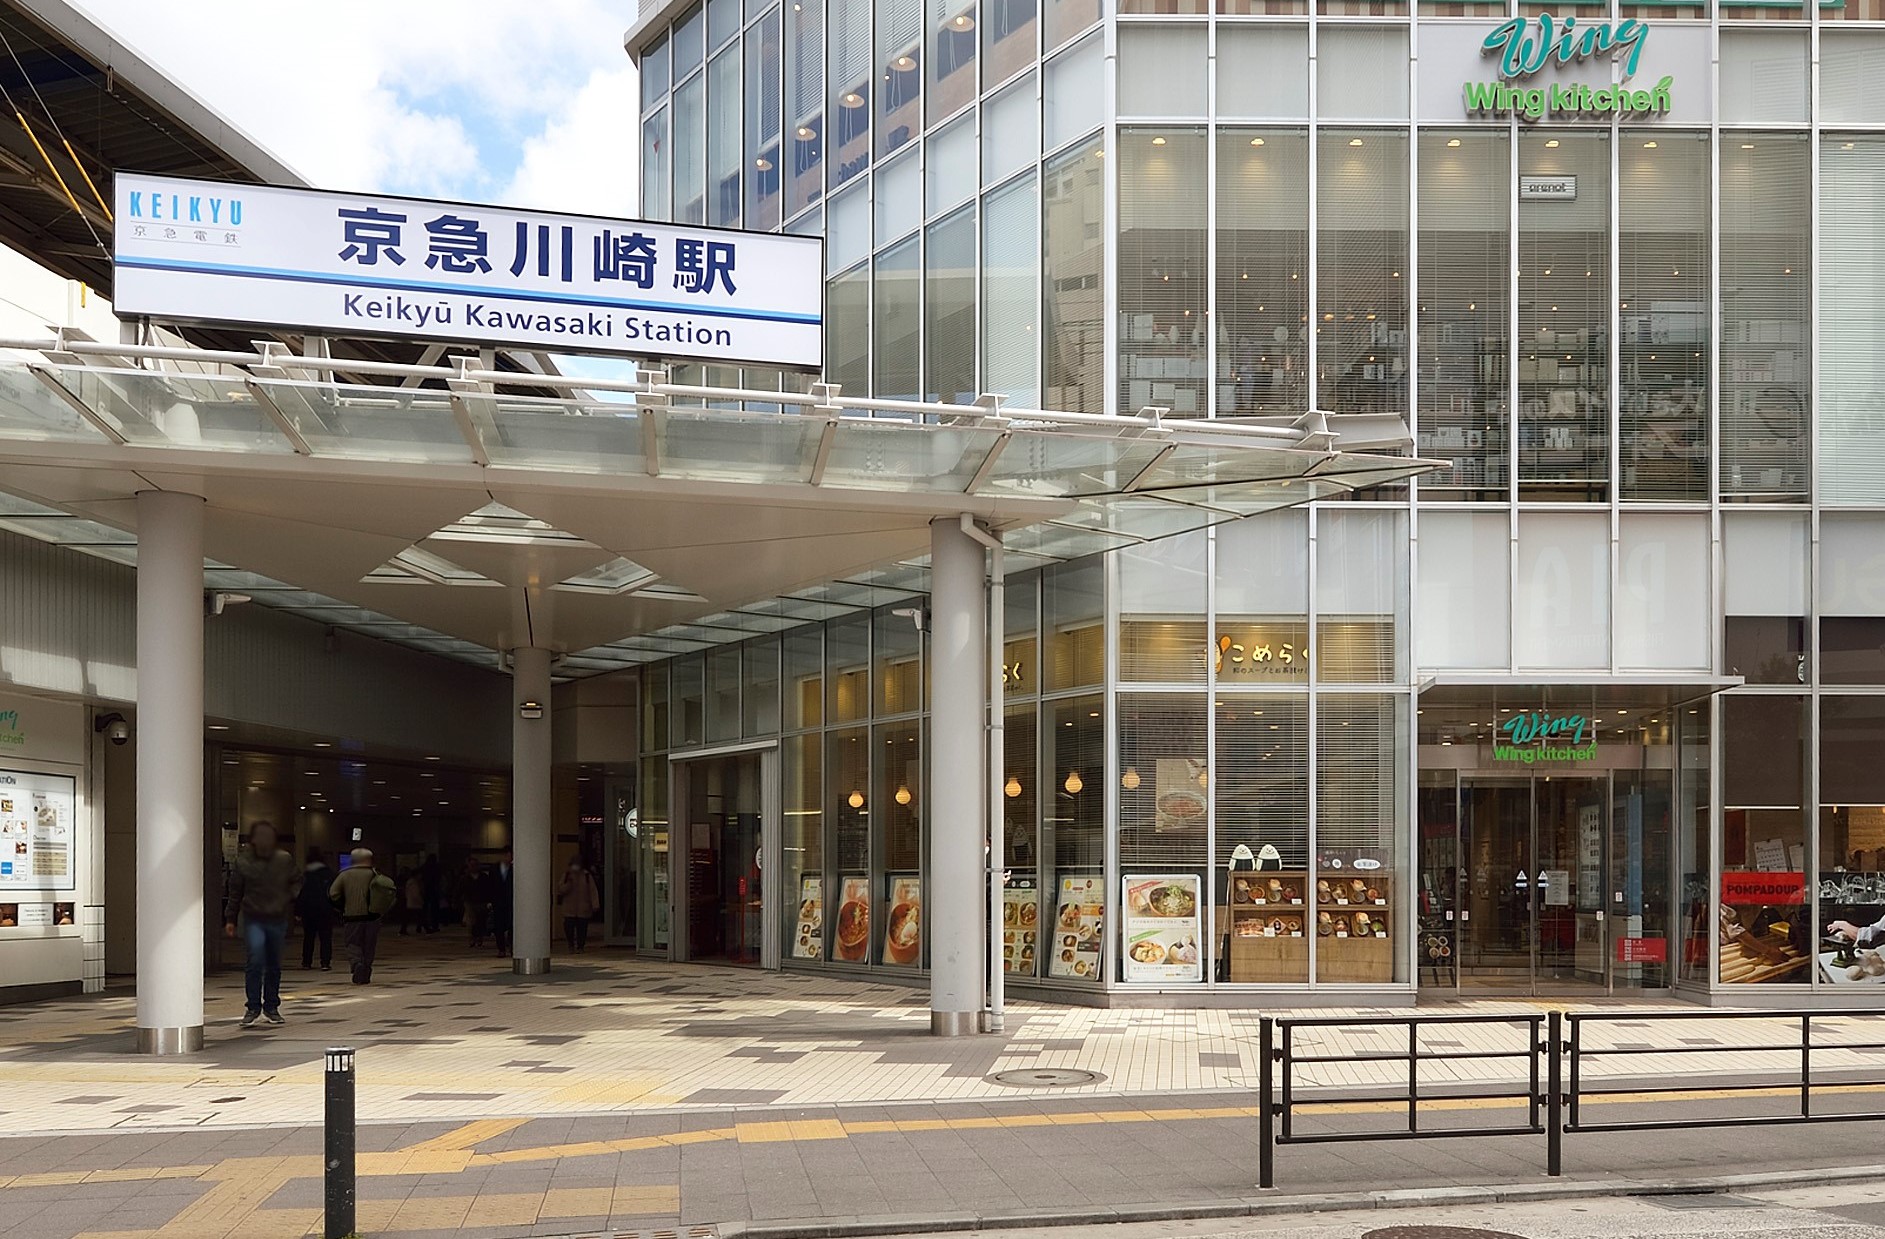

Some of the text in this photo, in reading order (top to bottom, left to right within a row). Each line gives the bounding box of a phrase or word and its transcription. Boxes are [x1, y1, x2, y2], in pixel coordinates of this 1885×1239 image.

[1483, 12, 1649, 78] Wing
[1464, 78, 1673, 118] Wing kitchen
[129, 190, 242, 226] KEIKYU
[133, 224, 239, 245] 京急電鉄
[337, 206, 738, 297] 京急川崎駅
[343, 293, 732, 347] Keikyū Kawasaki Station
[1502, 712, 1586, 745] Wing
[1494, 744, 1597, 764] Wing kitchen
[1726, 884, 1800, 896] POMPADOUR
